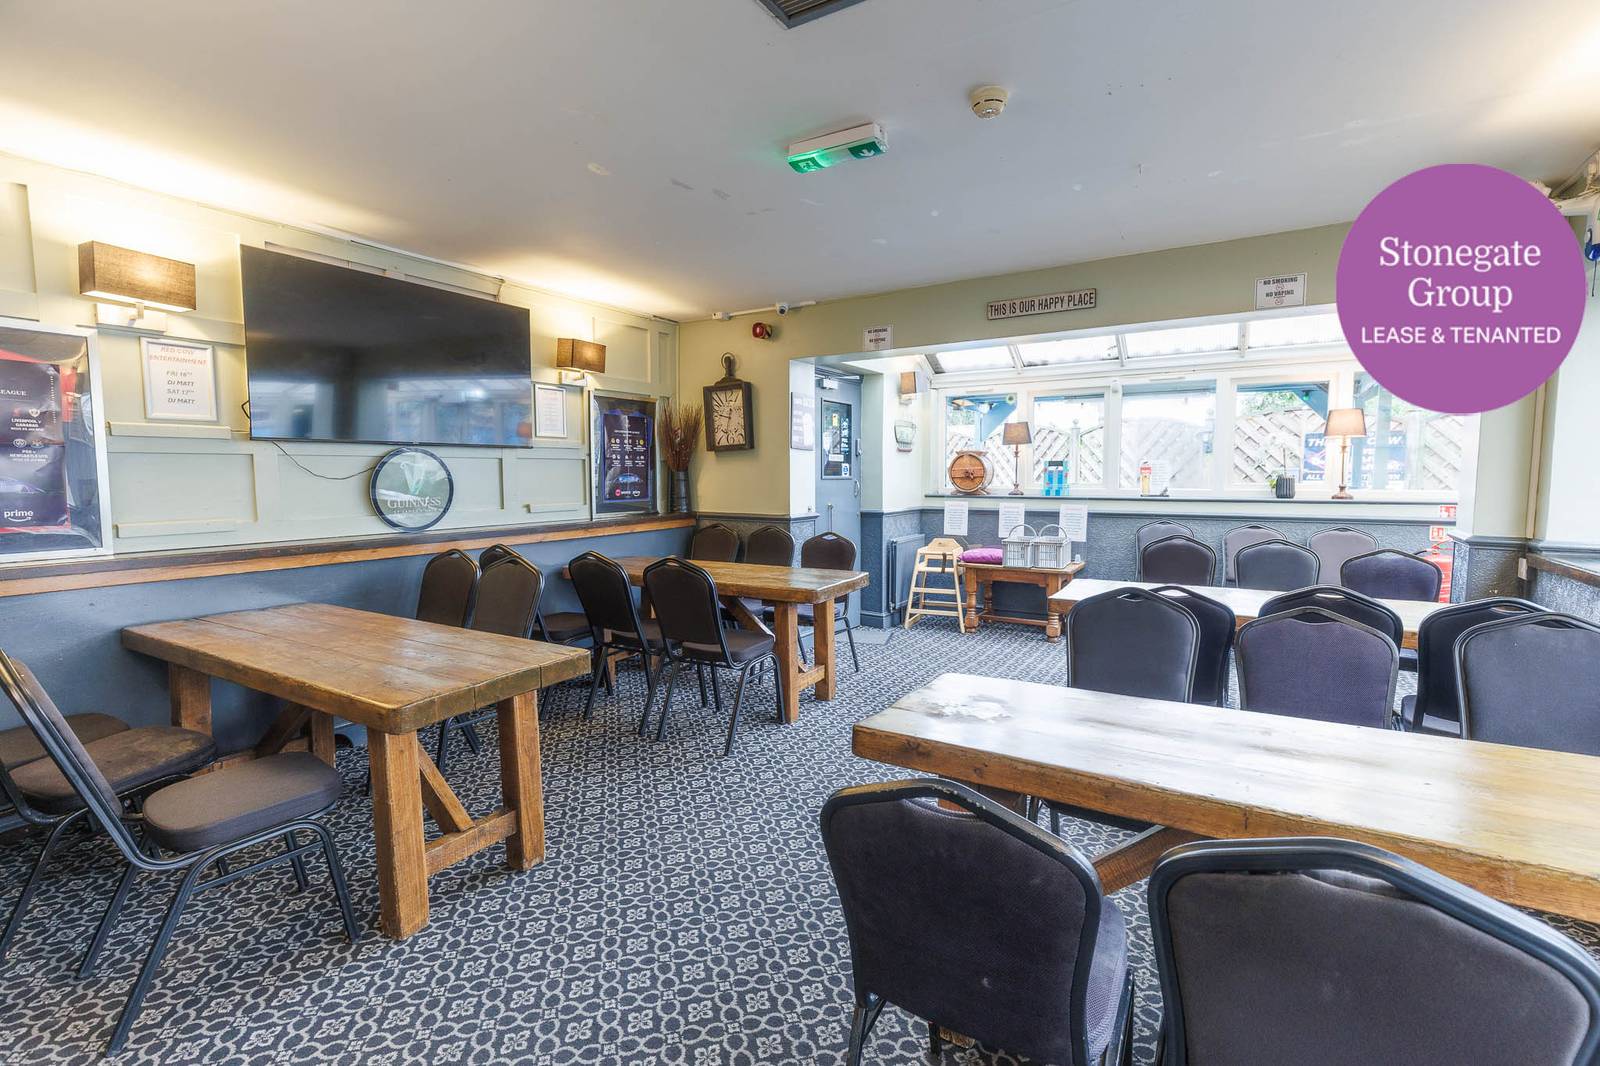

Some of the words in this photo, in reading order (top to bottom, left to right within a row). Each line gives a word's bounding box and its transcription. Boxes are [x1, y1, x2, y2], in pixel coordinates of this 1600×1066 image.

[989, 303, 1007, 317] THIS
[1009, 302, 1017, 314] IS
[1019, 300, 1036, 313] OUR
[1038, 295, 1065, 311] HAPPY
[1067, 292, 1094, 310] PLACE
[0, 388, 26, 396] EAGUE
[4, 509, 34, 518] prime
